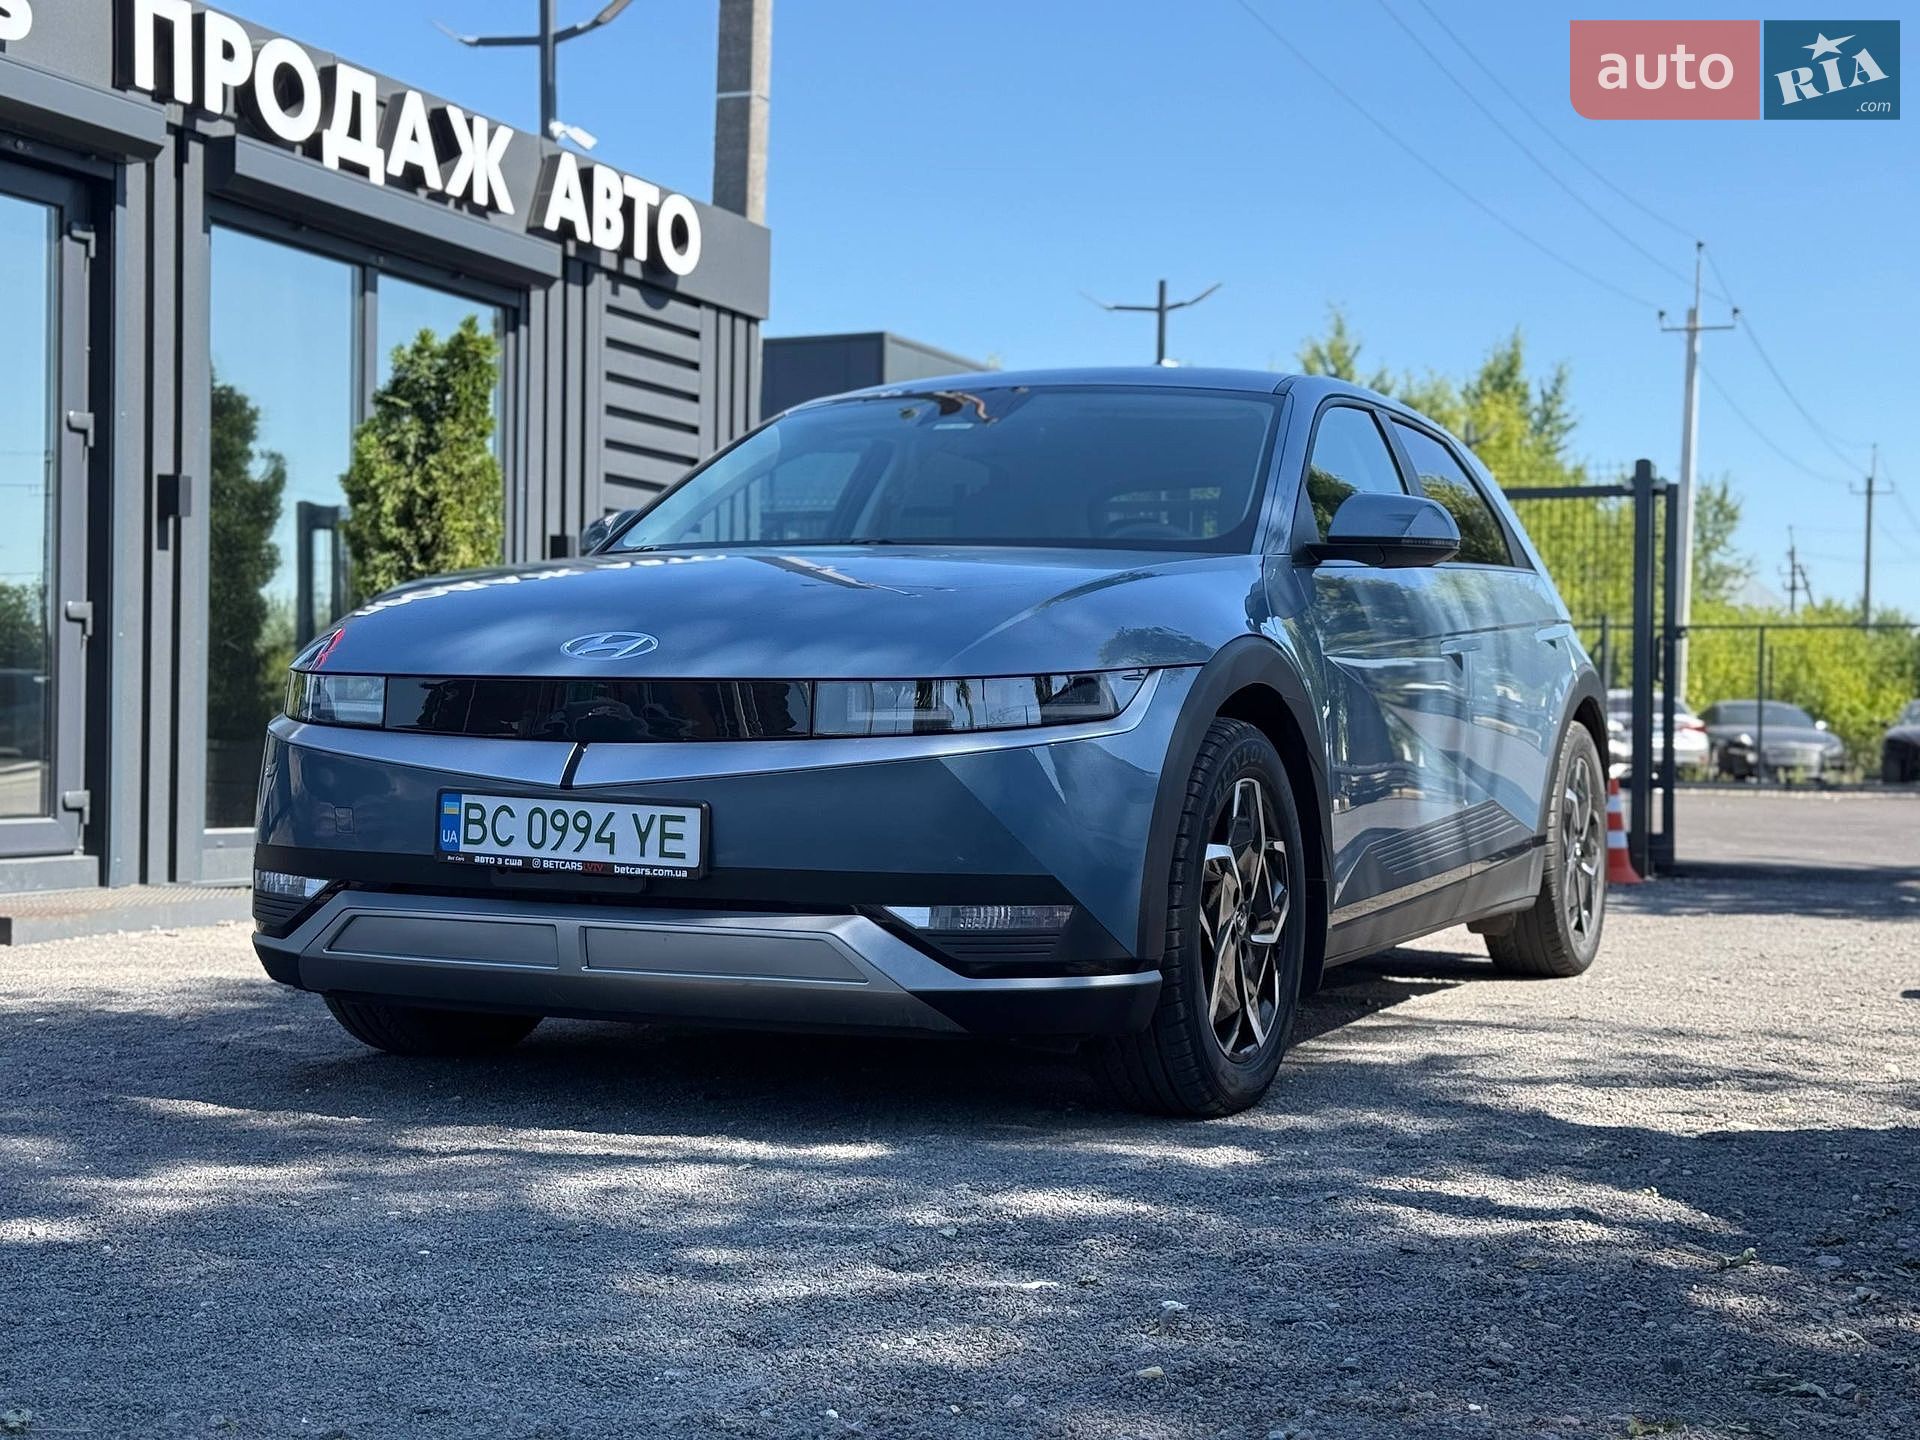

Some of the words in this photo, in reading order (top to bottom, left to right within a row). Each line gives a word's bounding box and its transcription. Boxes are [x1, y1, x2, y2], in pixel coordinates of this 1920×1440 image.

[134, 0, 516, 215] ПРОДАЖ
[543, 151, 702, 276] АВТО
[442, 829, 458, 843] UA
[463, 802, 516, 847] BC
[527, 806, 615, 855] 0994
[632, 812, 686, 859] YE
[614, 864, 688, 878] betcars.com.ua
